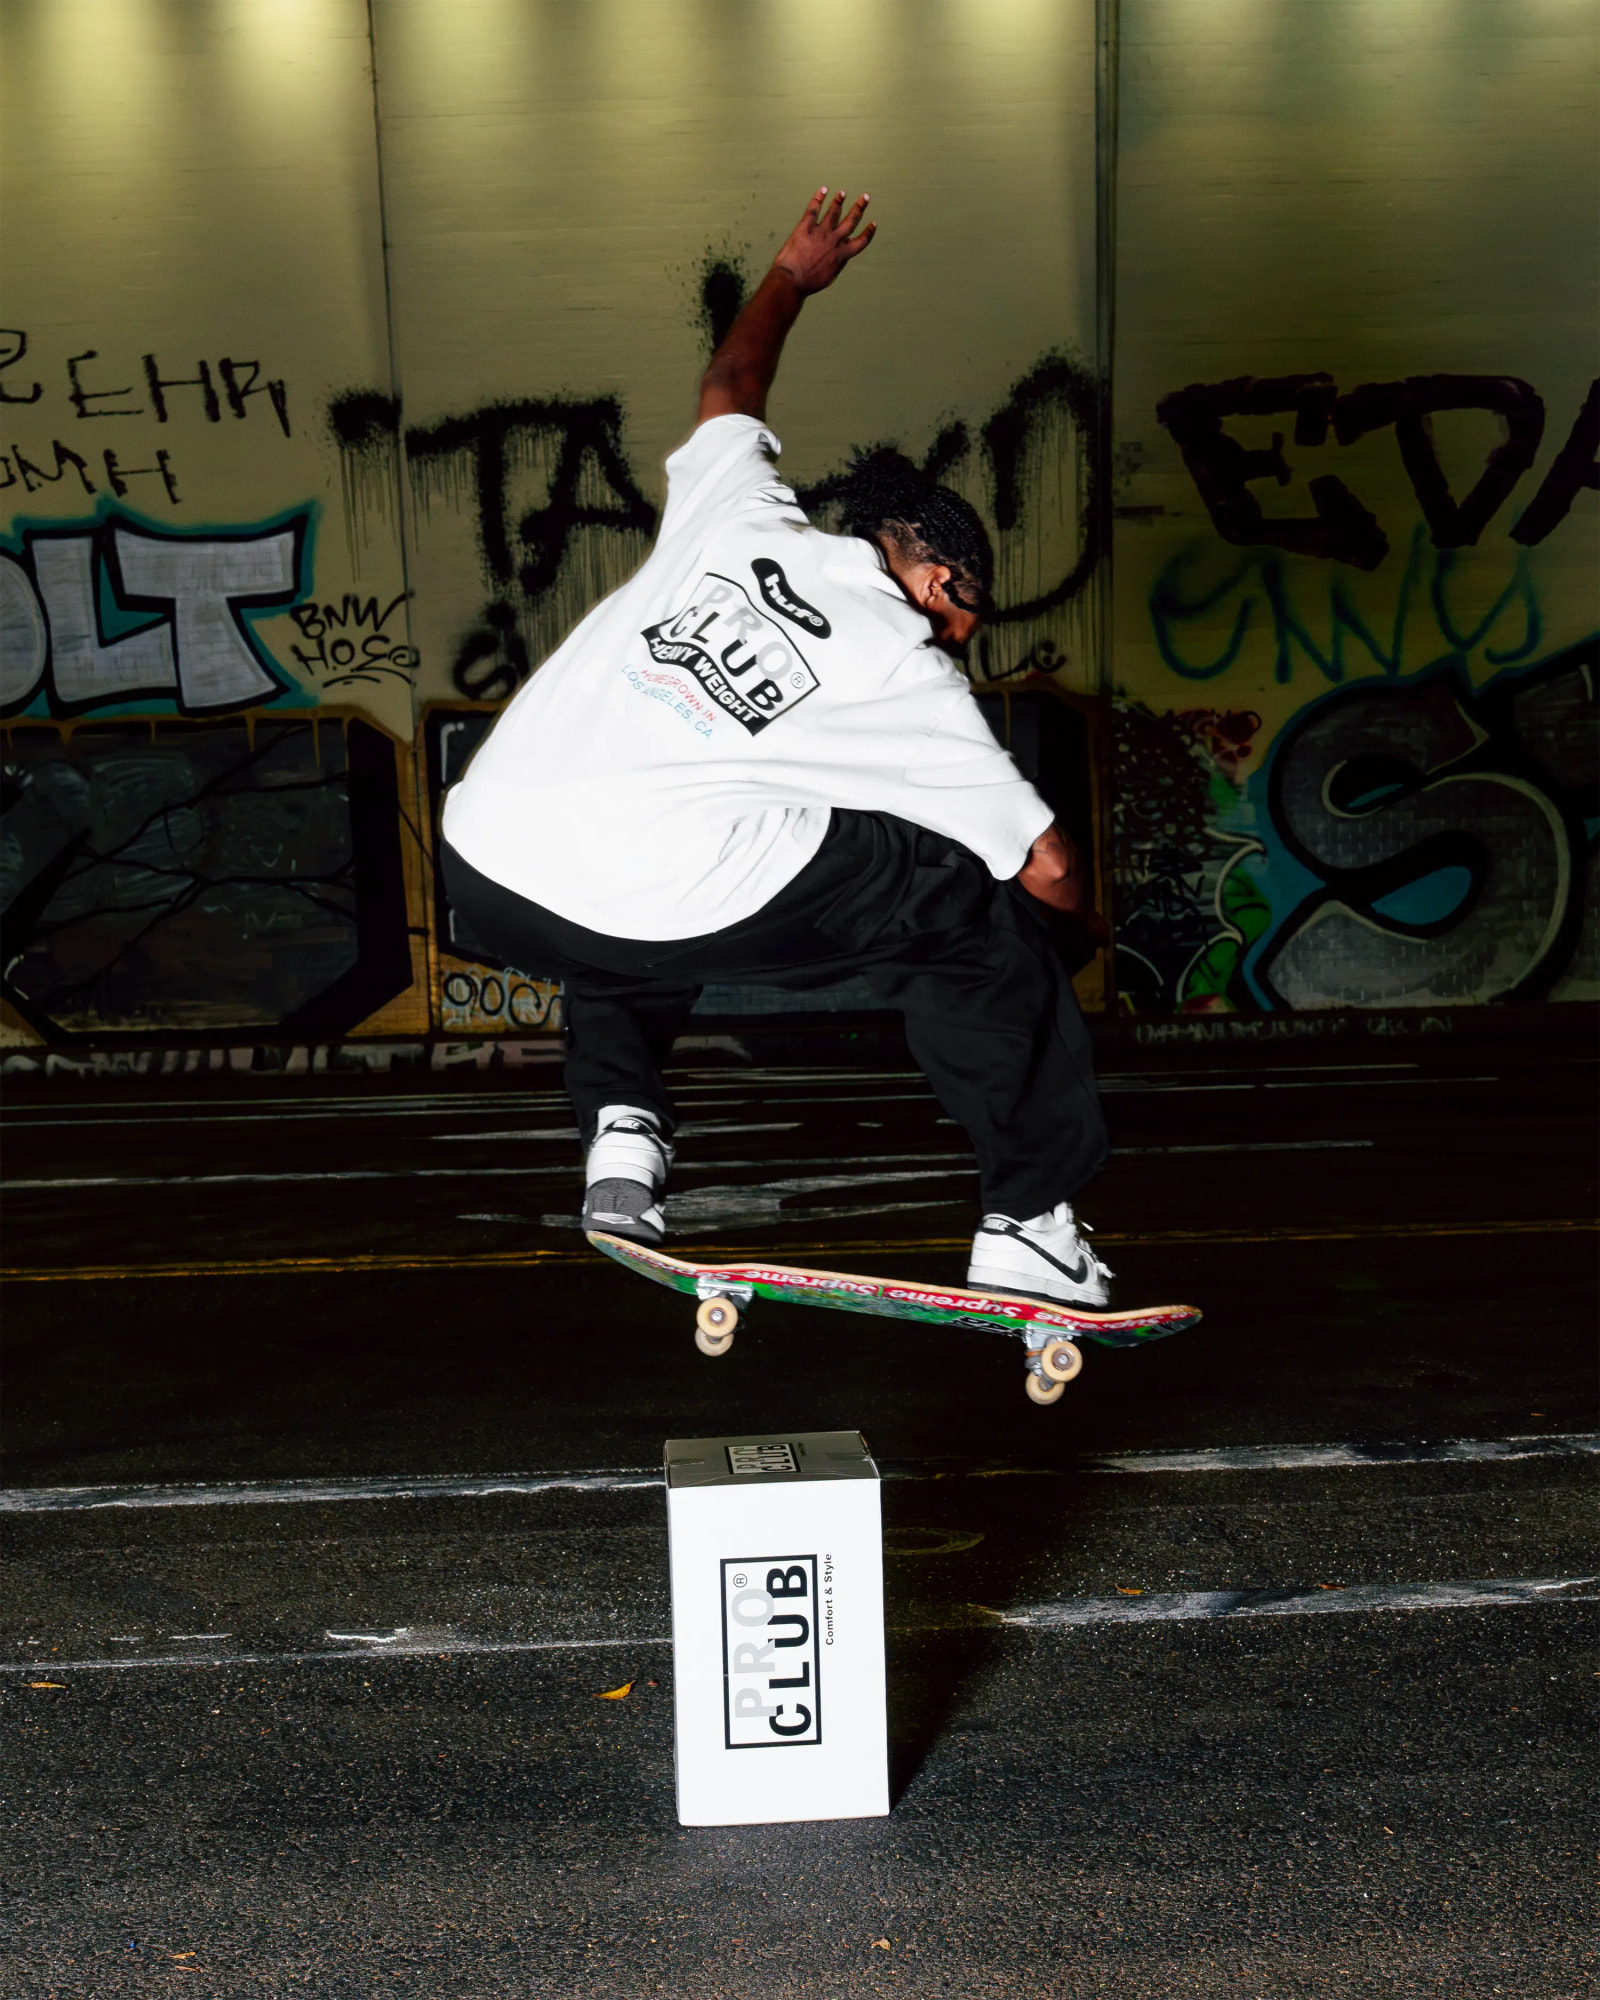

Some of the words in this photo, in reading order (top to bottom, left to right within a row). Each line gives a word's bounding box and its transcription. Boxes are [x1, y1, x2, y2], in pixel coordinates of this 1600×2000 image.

[701, 583, 793, 681] PRO
[669, 605, 784, 712] CLUB
[650, 637, 698, 662] HEAVY
[694, 656, 760, 723] WEIGHT
[621, 664, 645, 691] LOS
[694, 720, 713, 740] CA
[702, 709, 717, 722] IN
[743, 1269, 877, 1295] Supreme
[889, 1287, 1022, 1320] Supreme
[732, 1448, 767, 1470] PRO
[756, 1444, 793, 1472] CLUB
[824, 1553, 834, 1583] Style
[824, 1586, 833, 1595] &
[825, 1599, 834, 1646] Comfort
[731, 1588, 777, 1719] PRO
[766, 1565, 812, 1736] CLUB
